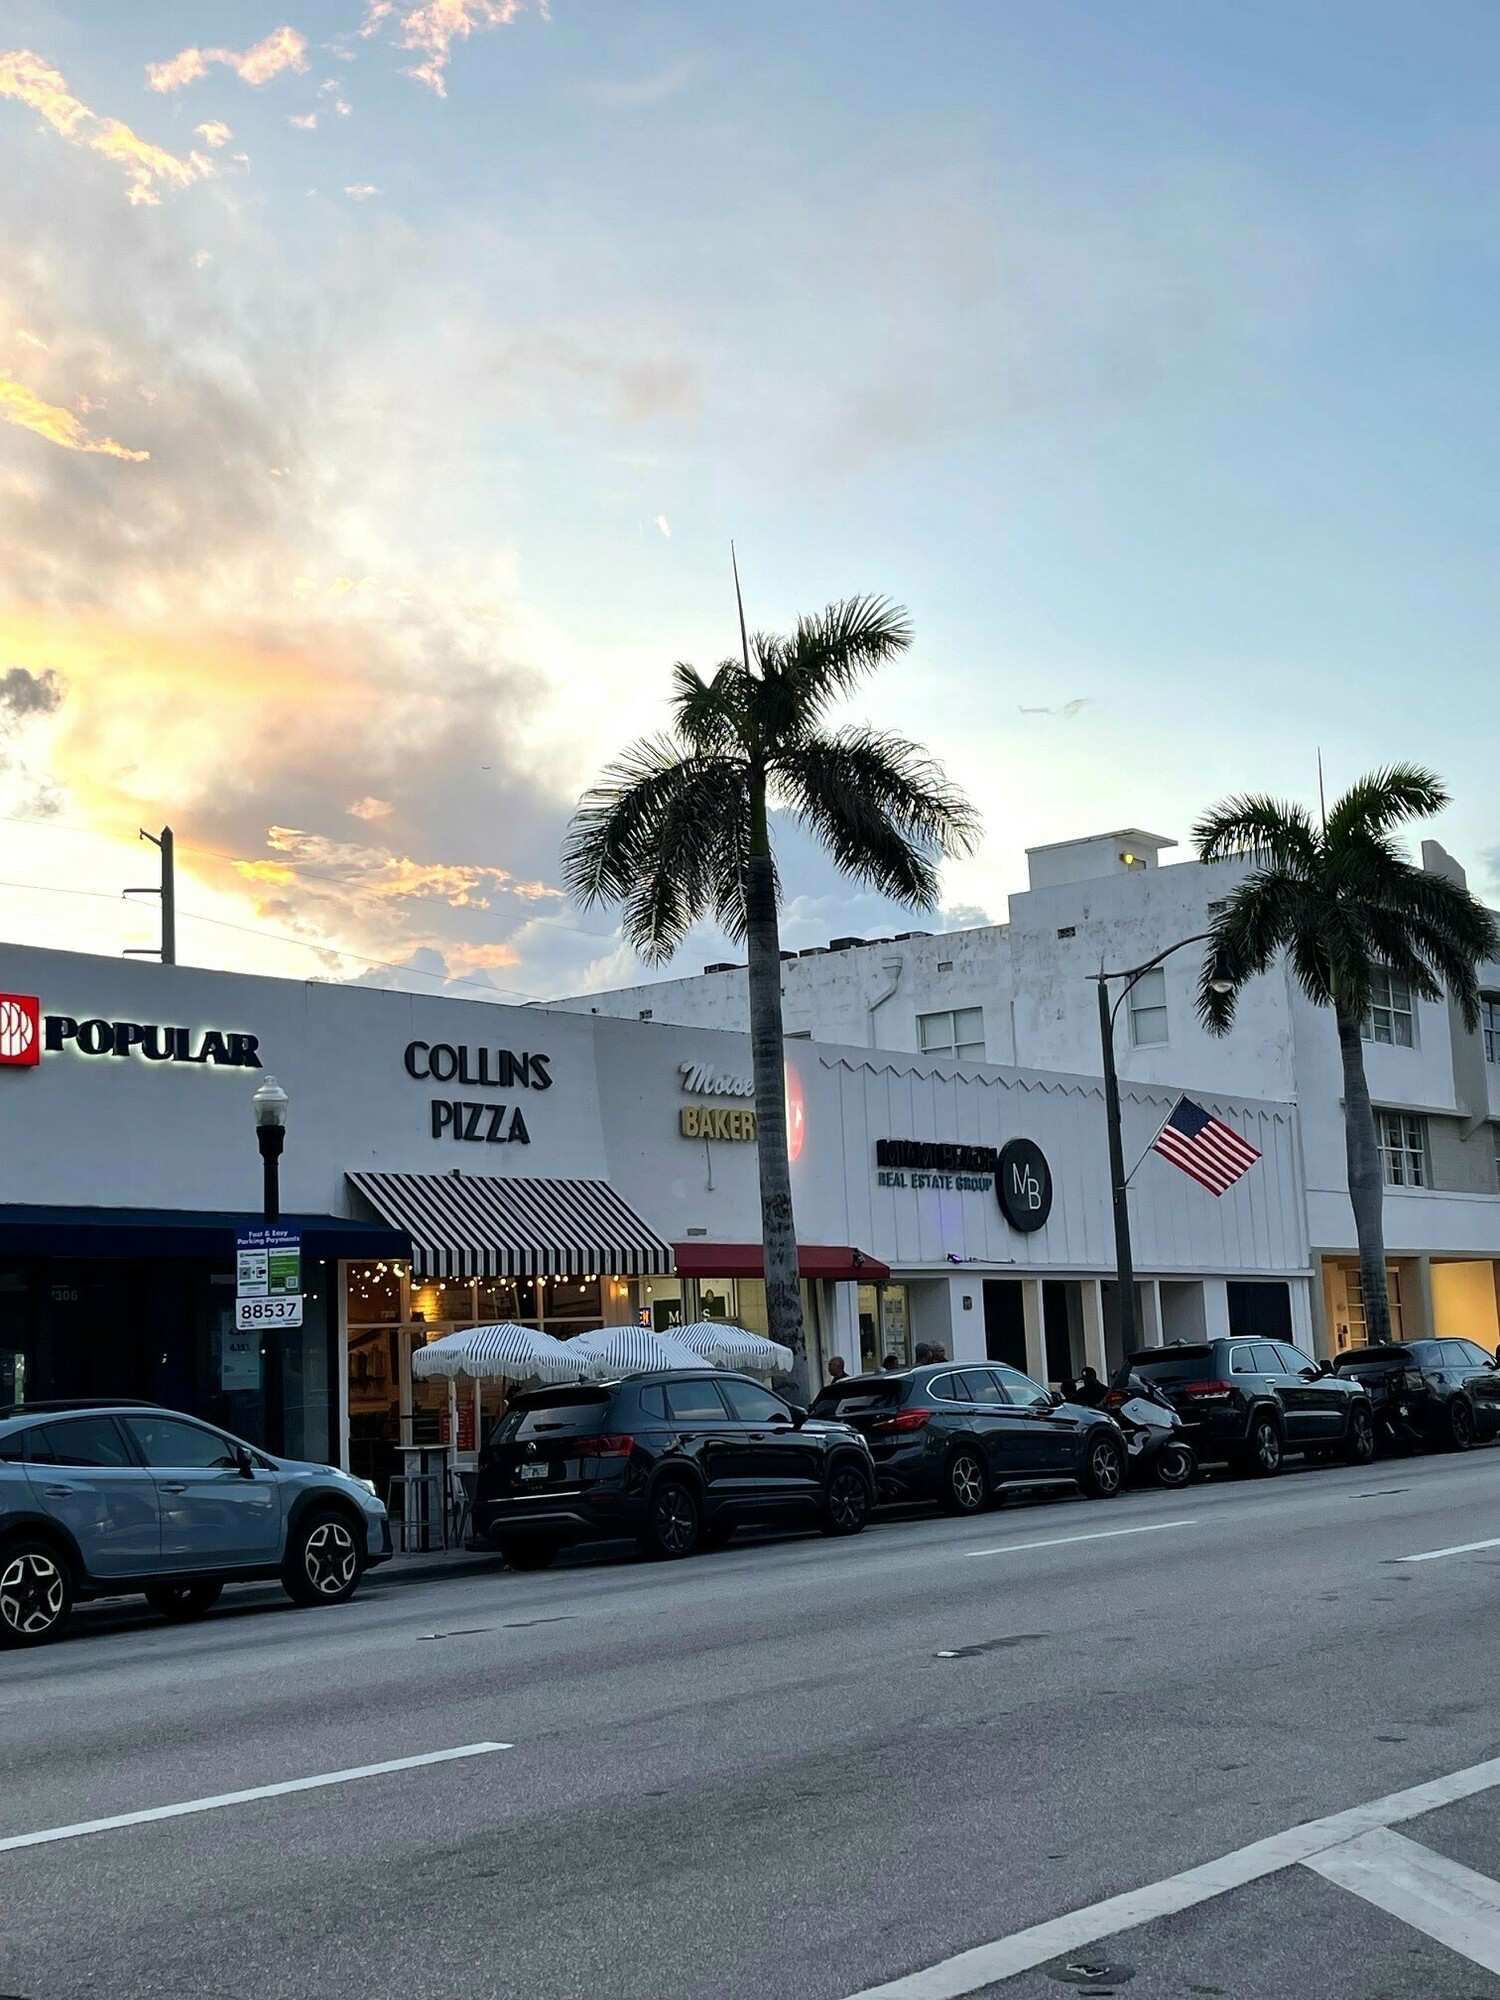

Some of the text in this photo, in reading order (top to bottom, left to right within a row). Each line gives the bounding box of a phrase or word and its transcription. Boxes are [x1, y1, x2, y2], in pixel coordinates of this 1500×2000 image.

[44, 1016, 263, 1068] POPULAR
[404, 1041, 553, 1090] COLLINS
[680, 1060, 755, 1097] Moise
[431, 1100, 531, 1145] PIZZA
[680, 1105, 757, 1140] BAKER
[878, 1172, 992, 1192] REAL ESTATE GROUP
[1012, 1162, 1042, 1210] MB
[266, 1236, 300, 1244] Payments
[241, 1303, 296, 1319] 88537
